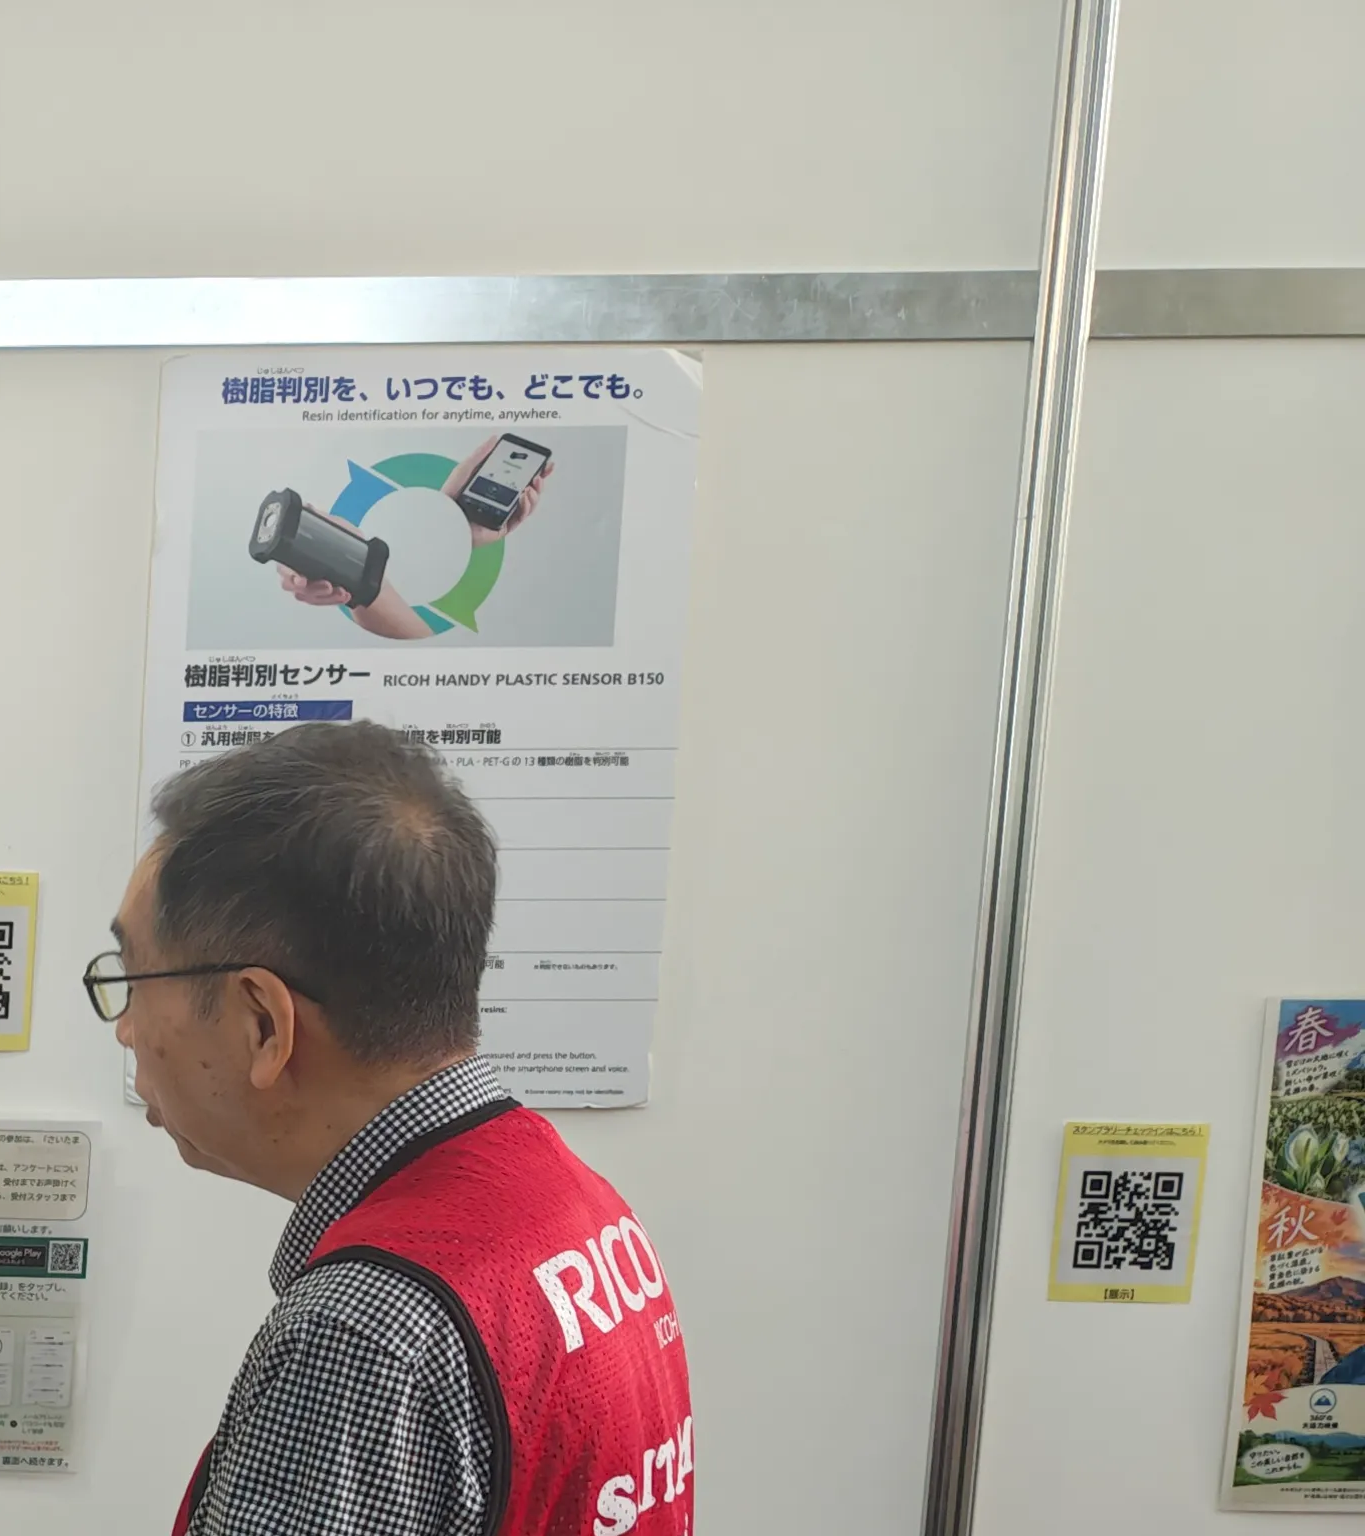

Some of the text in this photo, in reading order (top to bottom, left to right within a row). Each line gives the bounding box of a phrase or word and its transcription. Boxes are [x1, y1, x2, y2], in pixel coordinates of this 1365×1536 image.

[222, 375, 644, 404] 樹脂判別を、いつでも、どこでも。
[302, 408, 562, 423] Resin identification for anytime, anywhere.
[184, 663, 371, 688] 樹脂判別センサー
[383, 672, 664, 688] RICOH HANDY PLASTIC SENSOR B150
[193, 704, 298, 720] センサーの特徴
[1284, 1006, 1334, 1053] 春
[517, 1052, 531, 1060] and
[533, 1053, 553, 1062] press
[555, 1052, 568, 1060] the
[569, 1052, 597, 1060] button.
[503, 1065, 516, 1073] the
[517, 1065, 563, 1074] smartphone
[591, 1065, 606, 1073] and
[608, 1065, 629, 1073] voice.
[1267, 1204, 1320, 1249] 秋
[24, 1249, 42, 1259] Play
[533, 1211, 669, 1353] RICO
[1102, 1288, 1136, 1300] 【展示】
